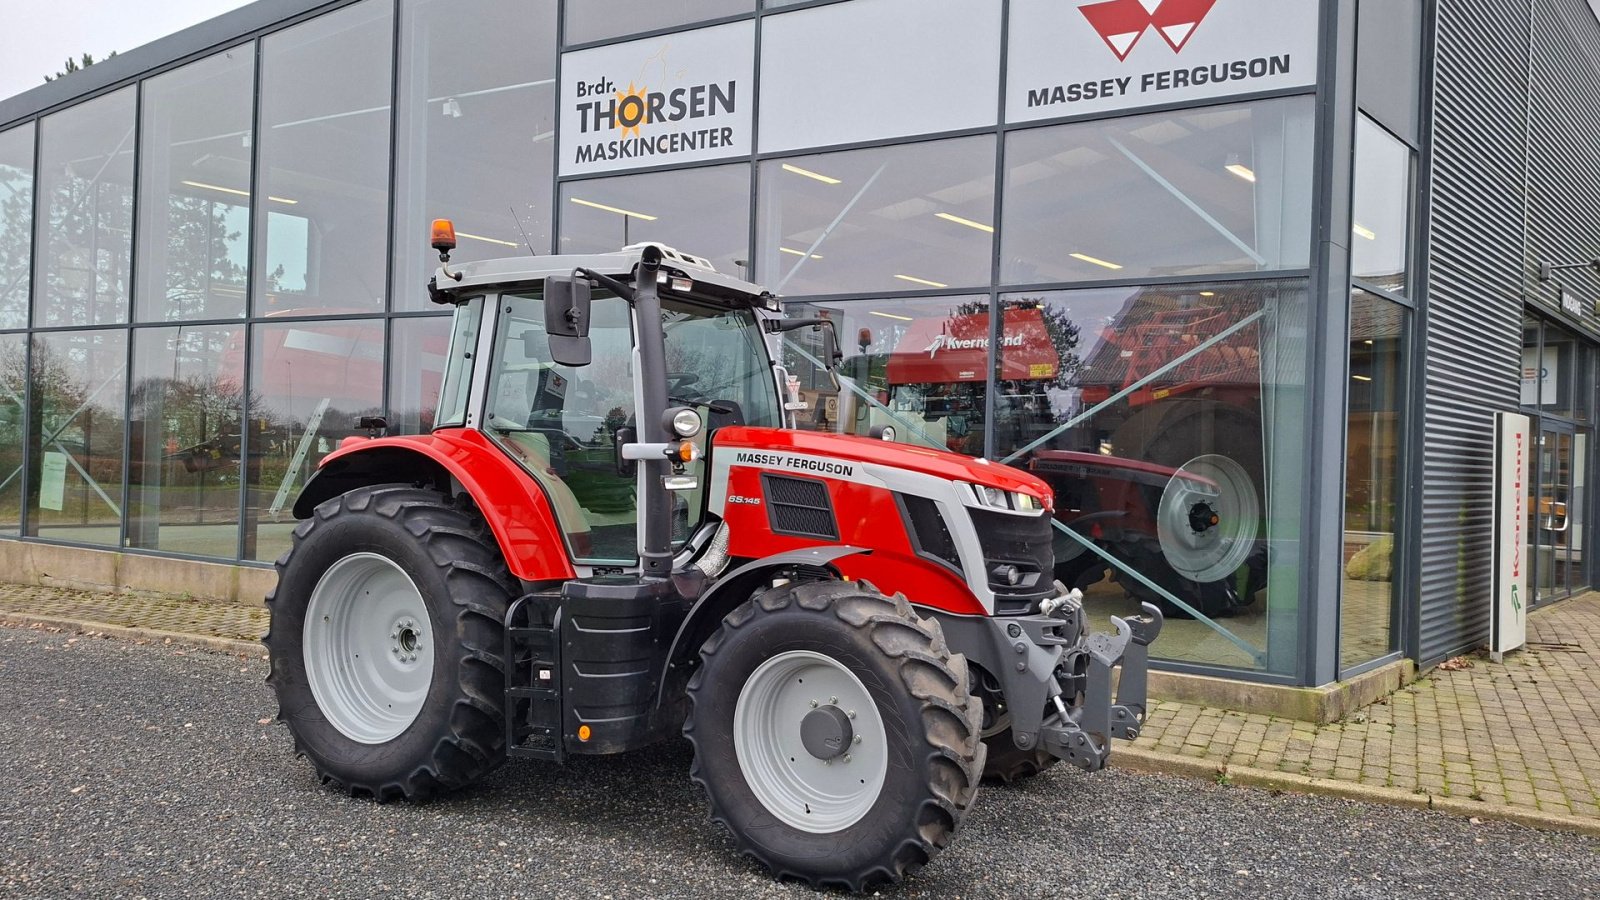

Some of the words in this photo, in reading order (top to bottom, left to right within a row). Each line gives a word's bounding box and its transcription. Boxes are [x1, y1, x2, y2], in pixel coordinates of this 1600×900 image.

[576, 76, 617, 98] Brdr.
[1028, 76, 1132, 107] MASSEY
[1140, 54, 1290, 92] FERGUSON
[576, 80, 736, 133] THORSEN
[575, 127, 734, 164] MASKINCENTER
[736, 453, 784, 466] MASSEY
[786, 457, 853, 476] FERGUSON
[728, 495, 761, 505] 6S.145
[1512, 432, 1523, 578] Kverneland
